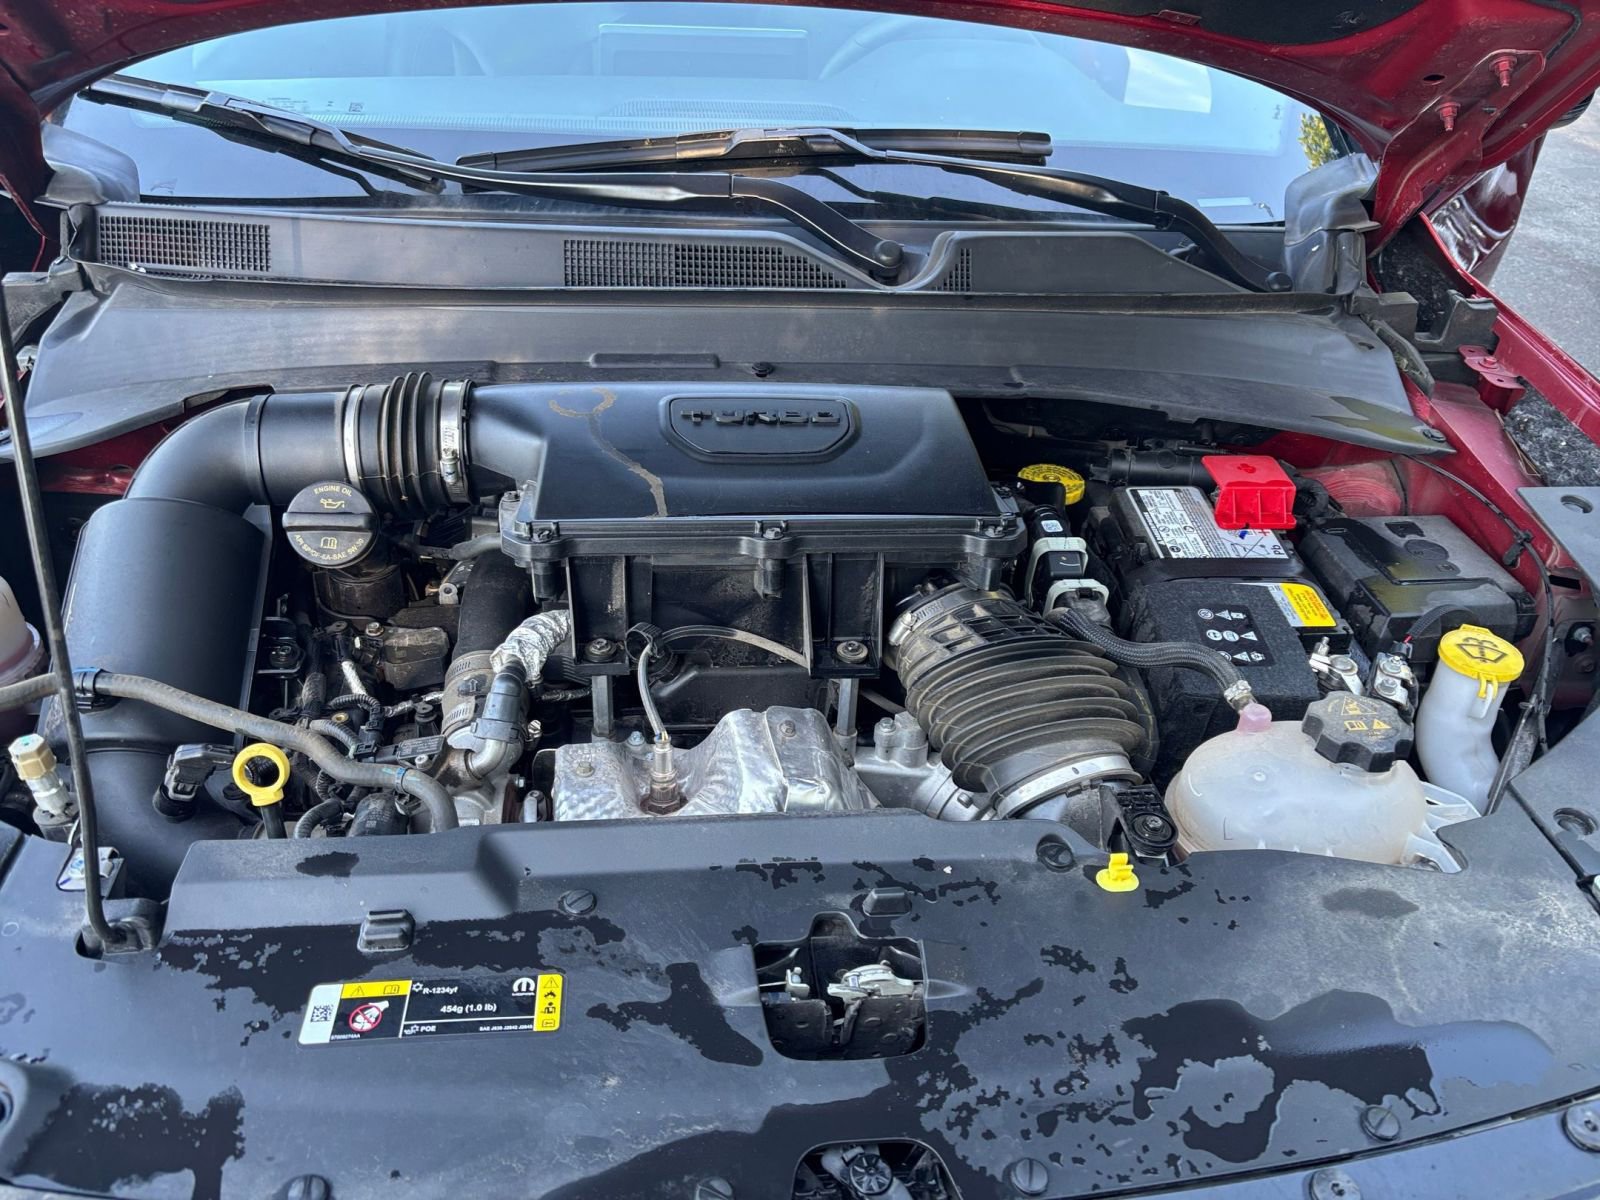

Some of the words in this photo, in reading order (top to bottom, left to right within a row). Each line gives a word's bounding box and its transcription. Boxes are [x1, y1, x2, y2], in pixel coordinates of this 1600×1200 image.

[314, 485, 340, 495] ENGINE
[341, 487, 352, 497] OIL
[1271, 544, 1285, 555] Pb
[422, 986, 459, 995] R-1234yf
[440, 1004, 463, 1014] 454g
[465, 1003, 483, 1013] (1.0
[484, 1002, 497, 1012] lb)
[420, 1025, 437, 1033] POE
